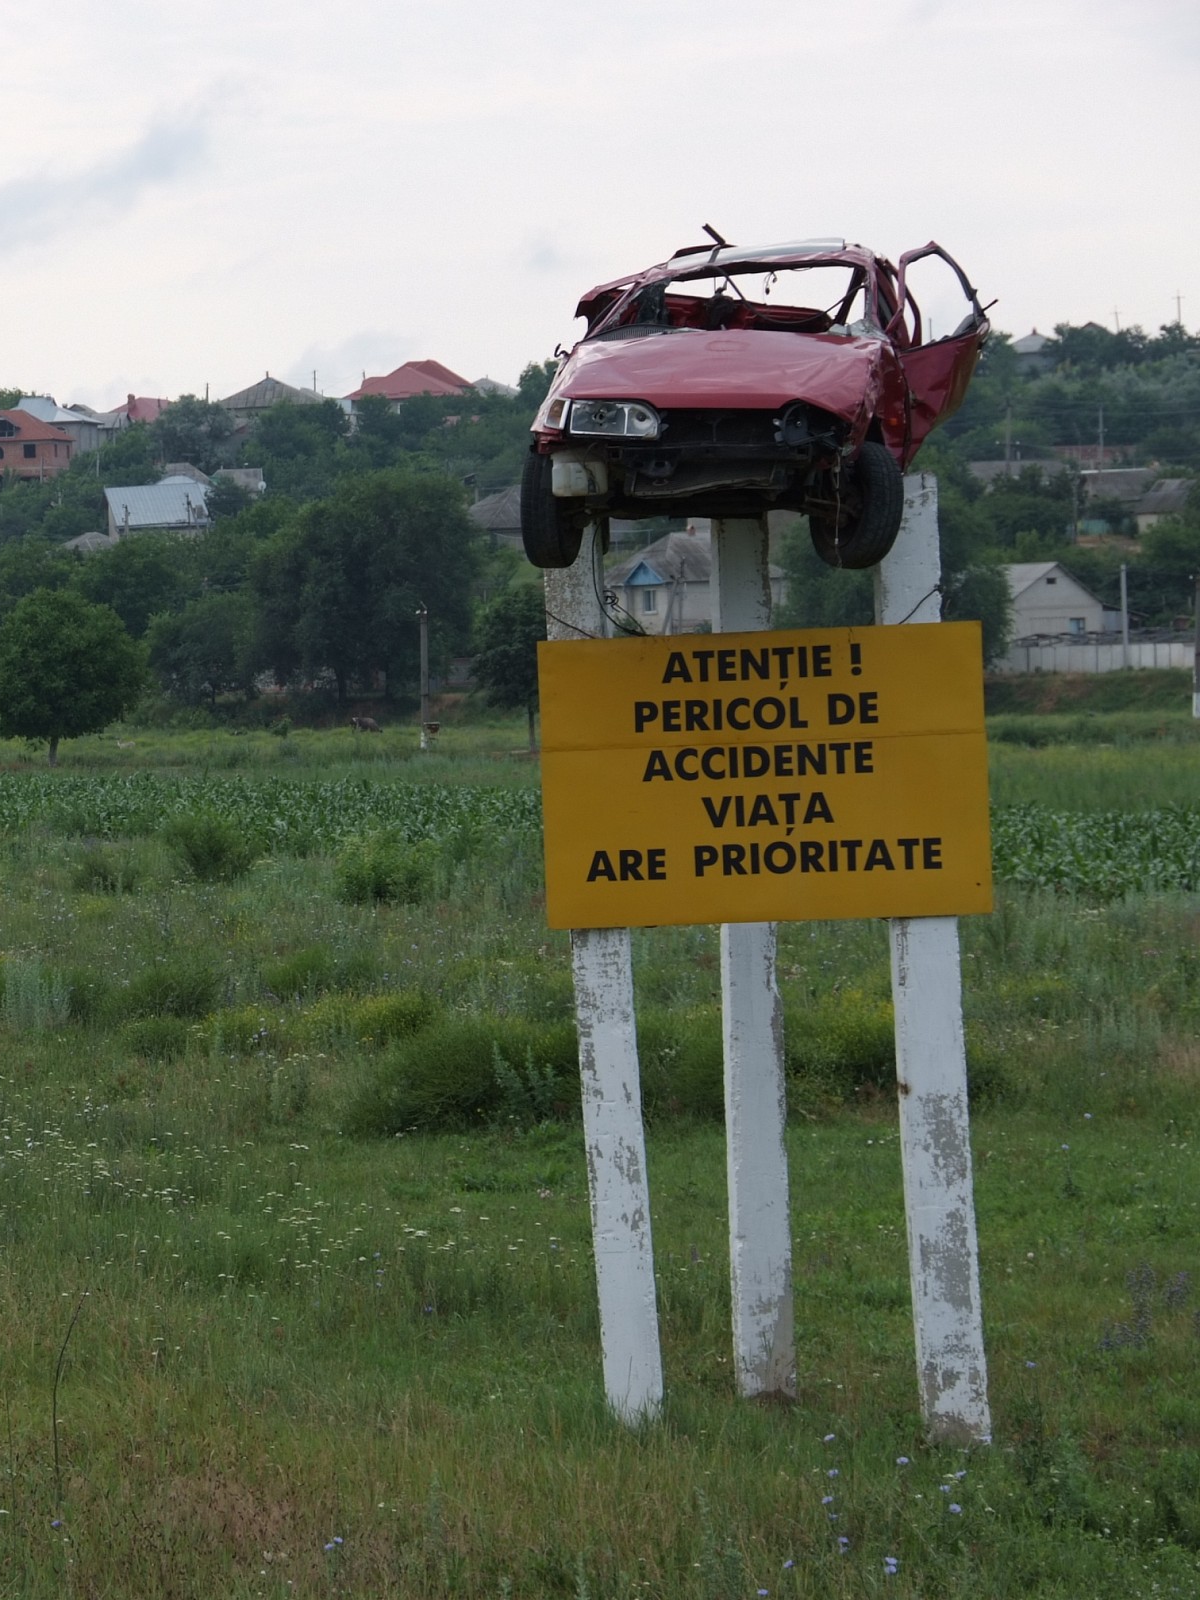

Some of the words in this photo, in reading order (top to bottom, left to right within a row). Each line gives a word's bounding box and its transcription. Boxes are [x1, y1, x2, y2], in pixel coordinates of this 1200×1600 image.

[661, 645, 833, 690] ATENȚIE
[850, 643, 862, 676] !
[634, 697, 809, 733] PERICOL
[827, 691, 879, 726] DE
[642, 741, 874, 782] ACCIDENTE
[701, 792, 835, 836] VIAȚA
[586, 849, 667, 883] ARE
[694, 837, 943, 878] PRIORITATE
